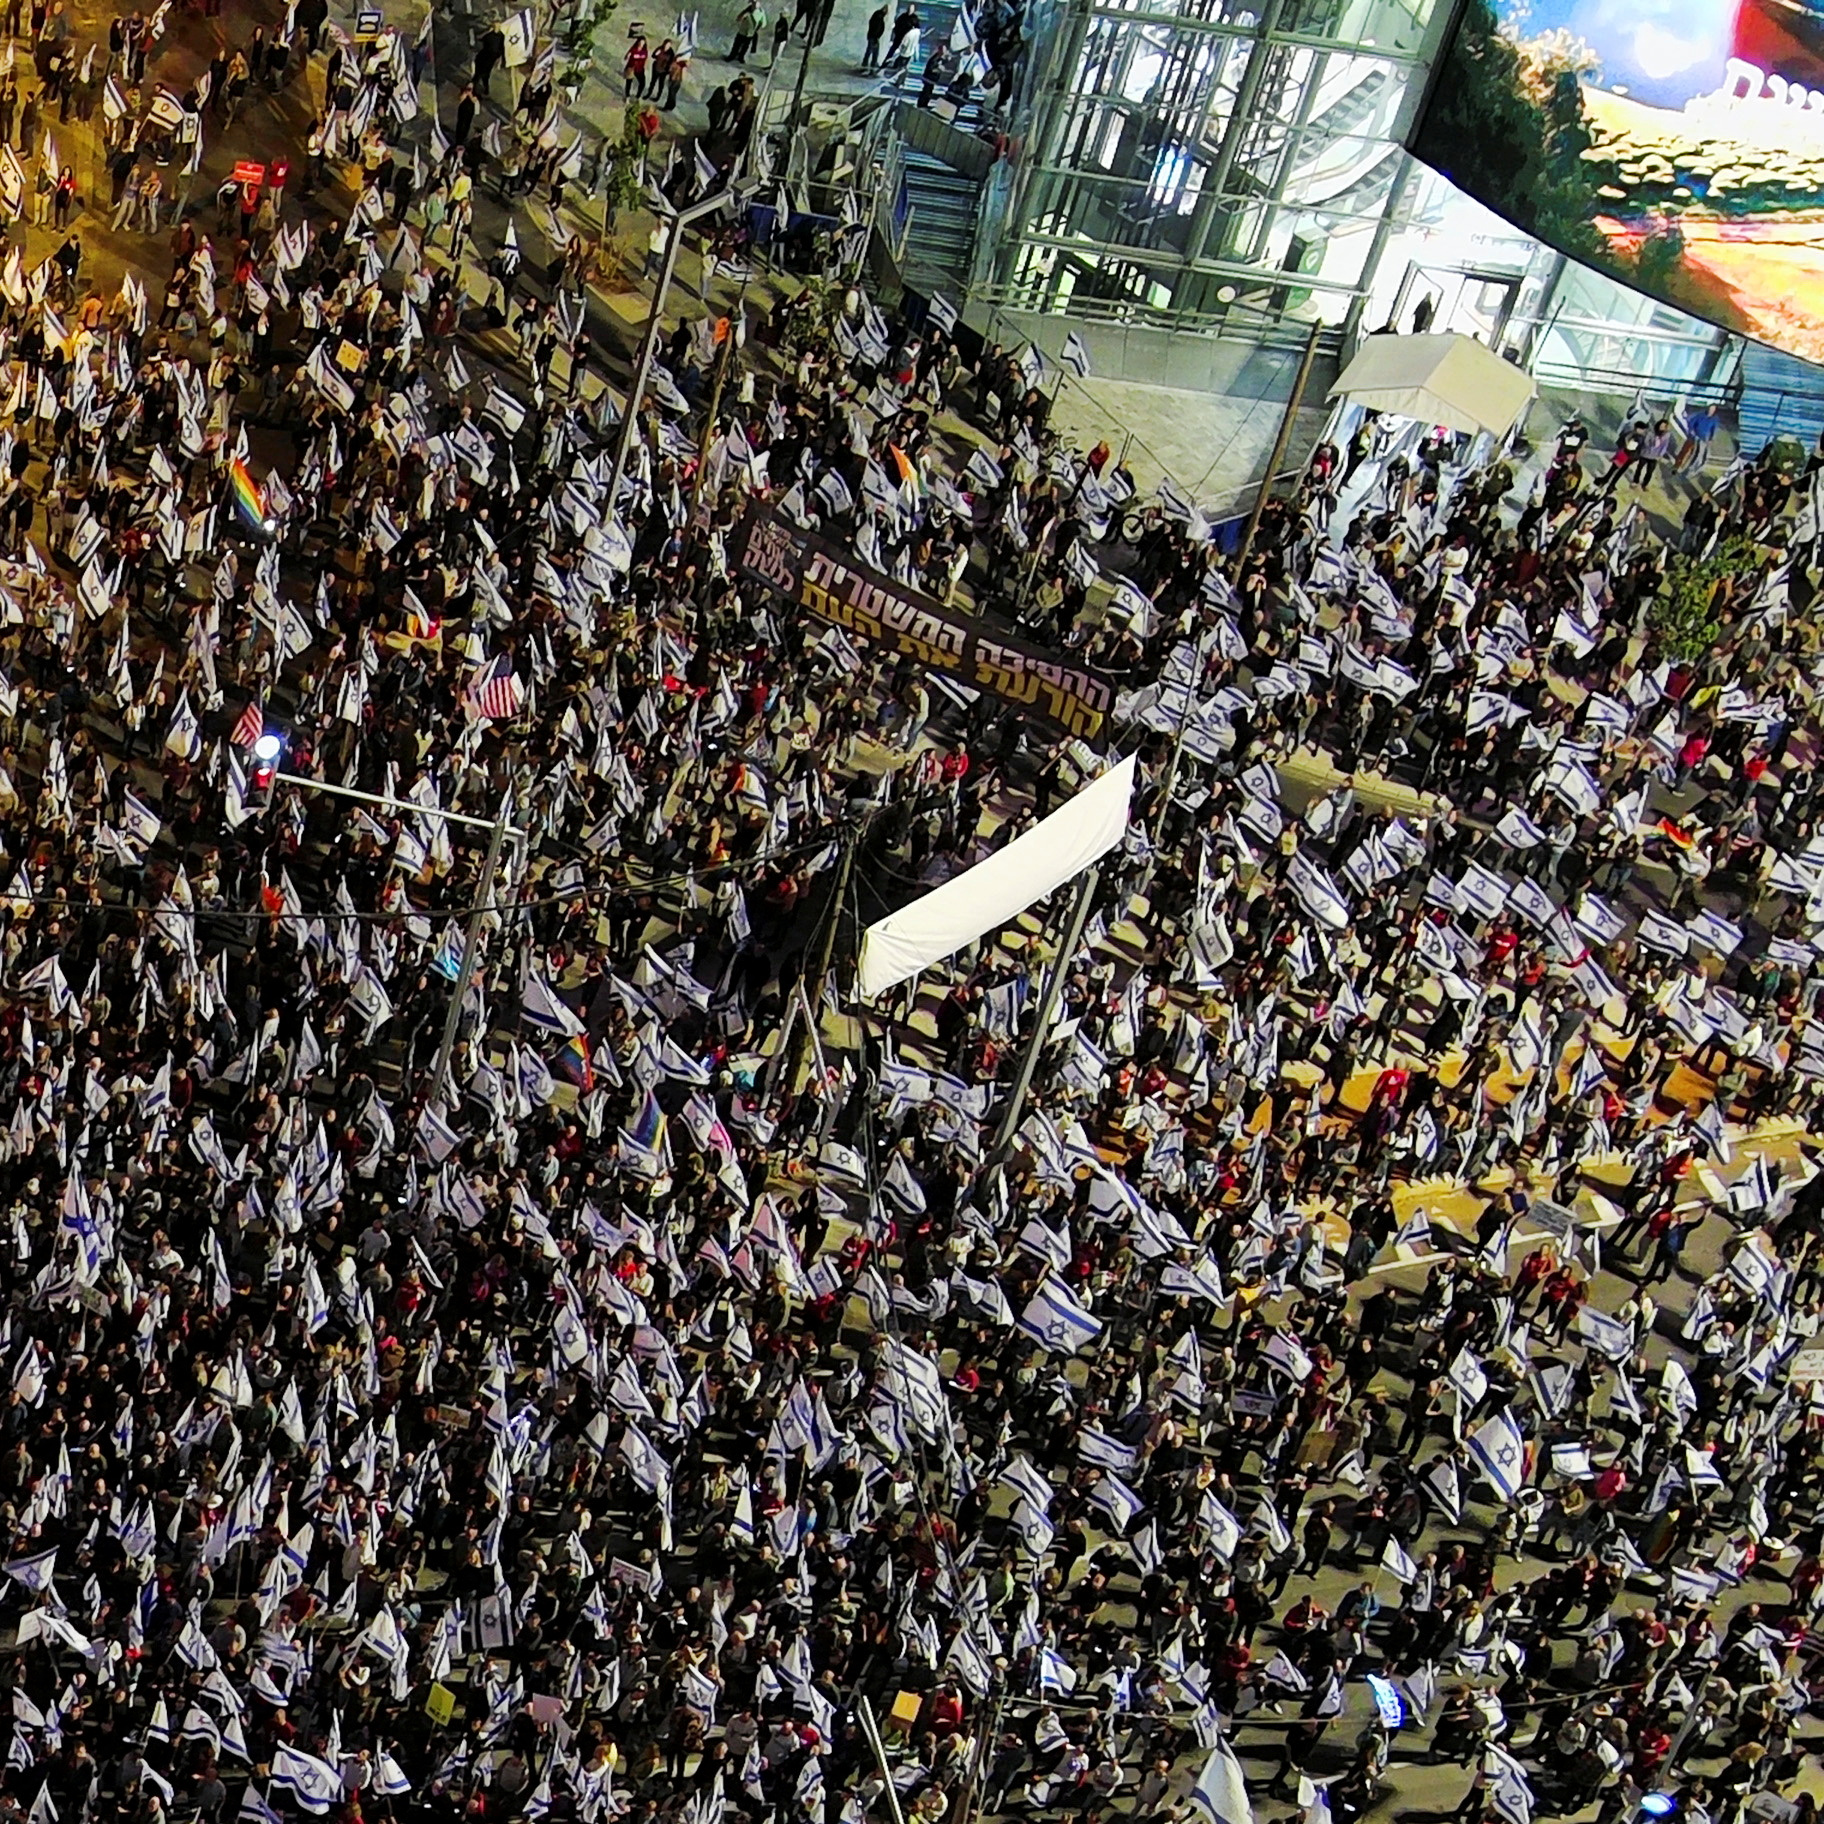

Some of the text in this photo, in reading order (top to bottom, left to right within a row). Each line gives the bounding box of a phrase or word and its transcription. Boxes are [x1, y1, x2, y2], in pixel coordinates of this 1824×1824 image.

[801, 579, 887, 641] העם
[805, 550, 966, 662] המשטרית
[897, 628, 963, 671] את
